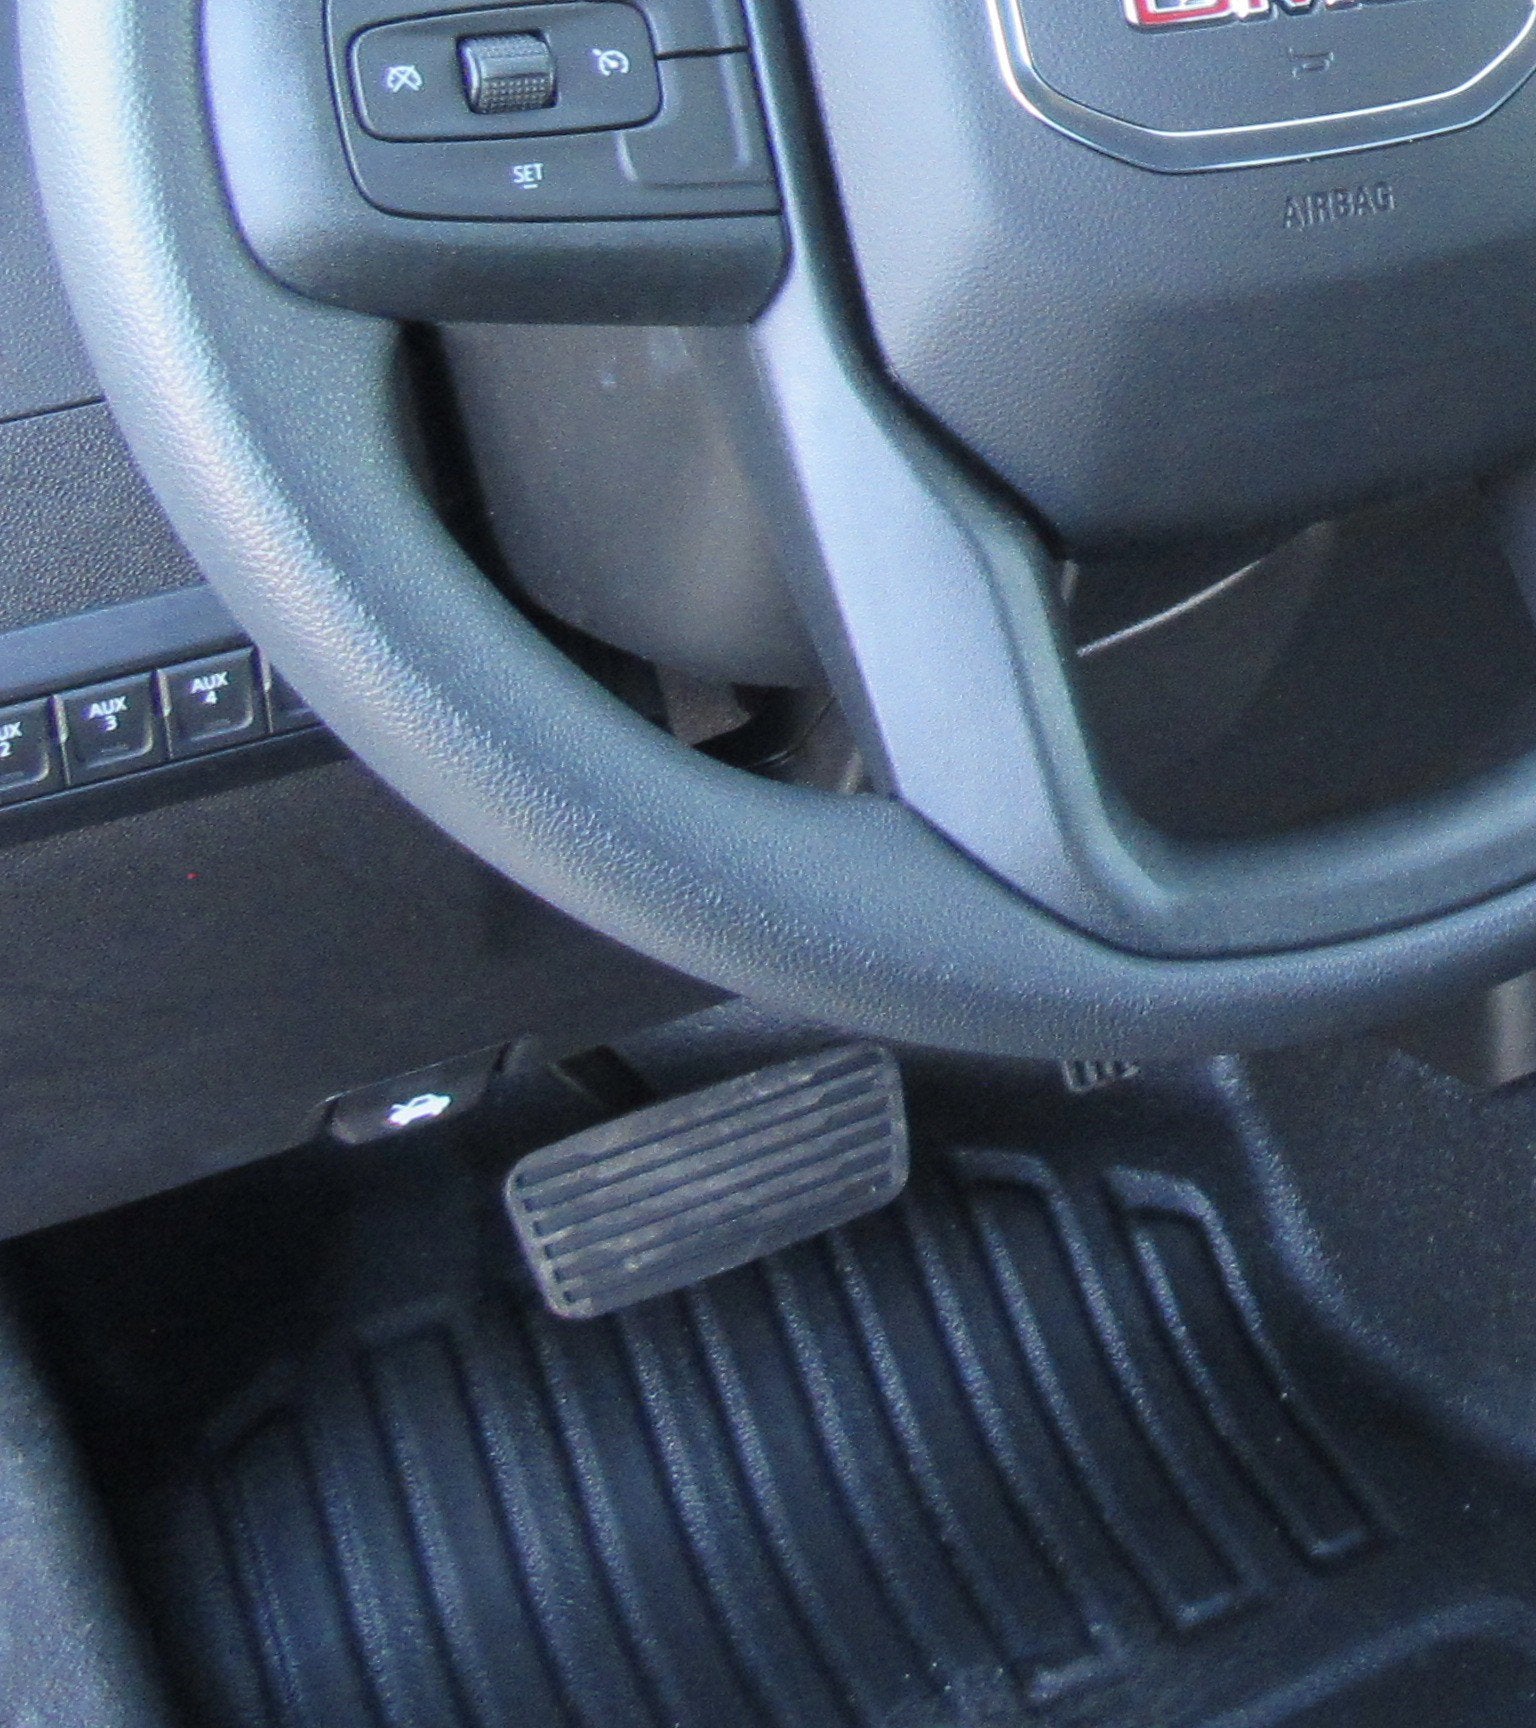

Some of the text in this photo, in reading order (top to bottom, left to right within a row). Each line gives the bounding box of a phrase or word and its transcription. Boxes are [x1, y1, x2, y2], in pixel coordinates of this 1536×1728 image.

[513, 163, 544, 183] SET
[1284, 182, 1395, 228] AIRBAG
[191, 671, 229, 694] AUX
[88, 696, 129, 719] AUX
[204, 690, 217, 705] 4
[0, 721, 22, 741] UX
[104, 715, 118, 732] 3
